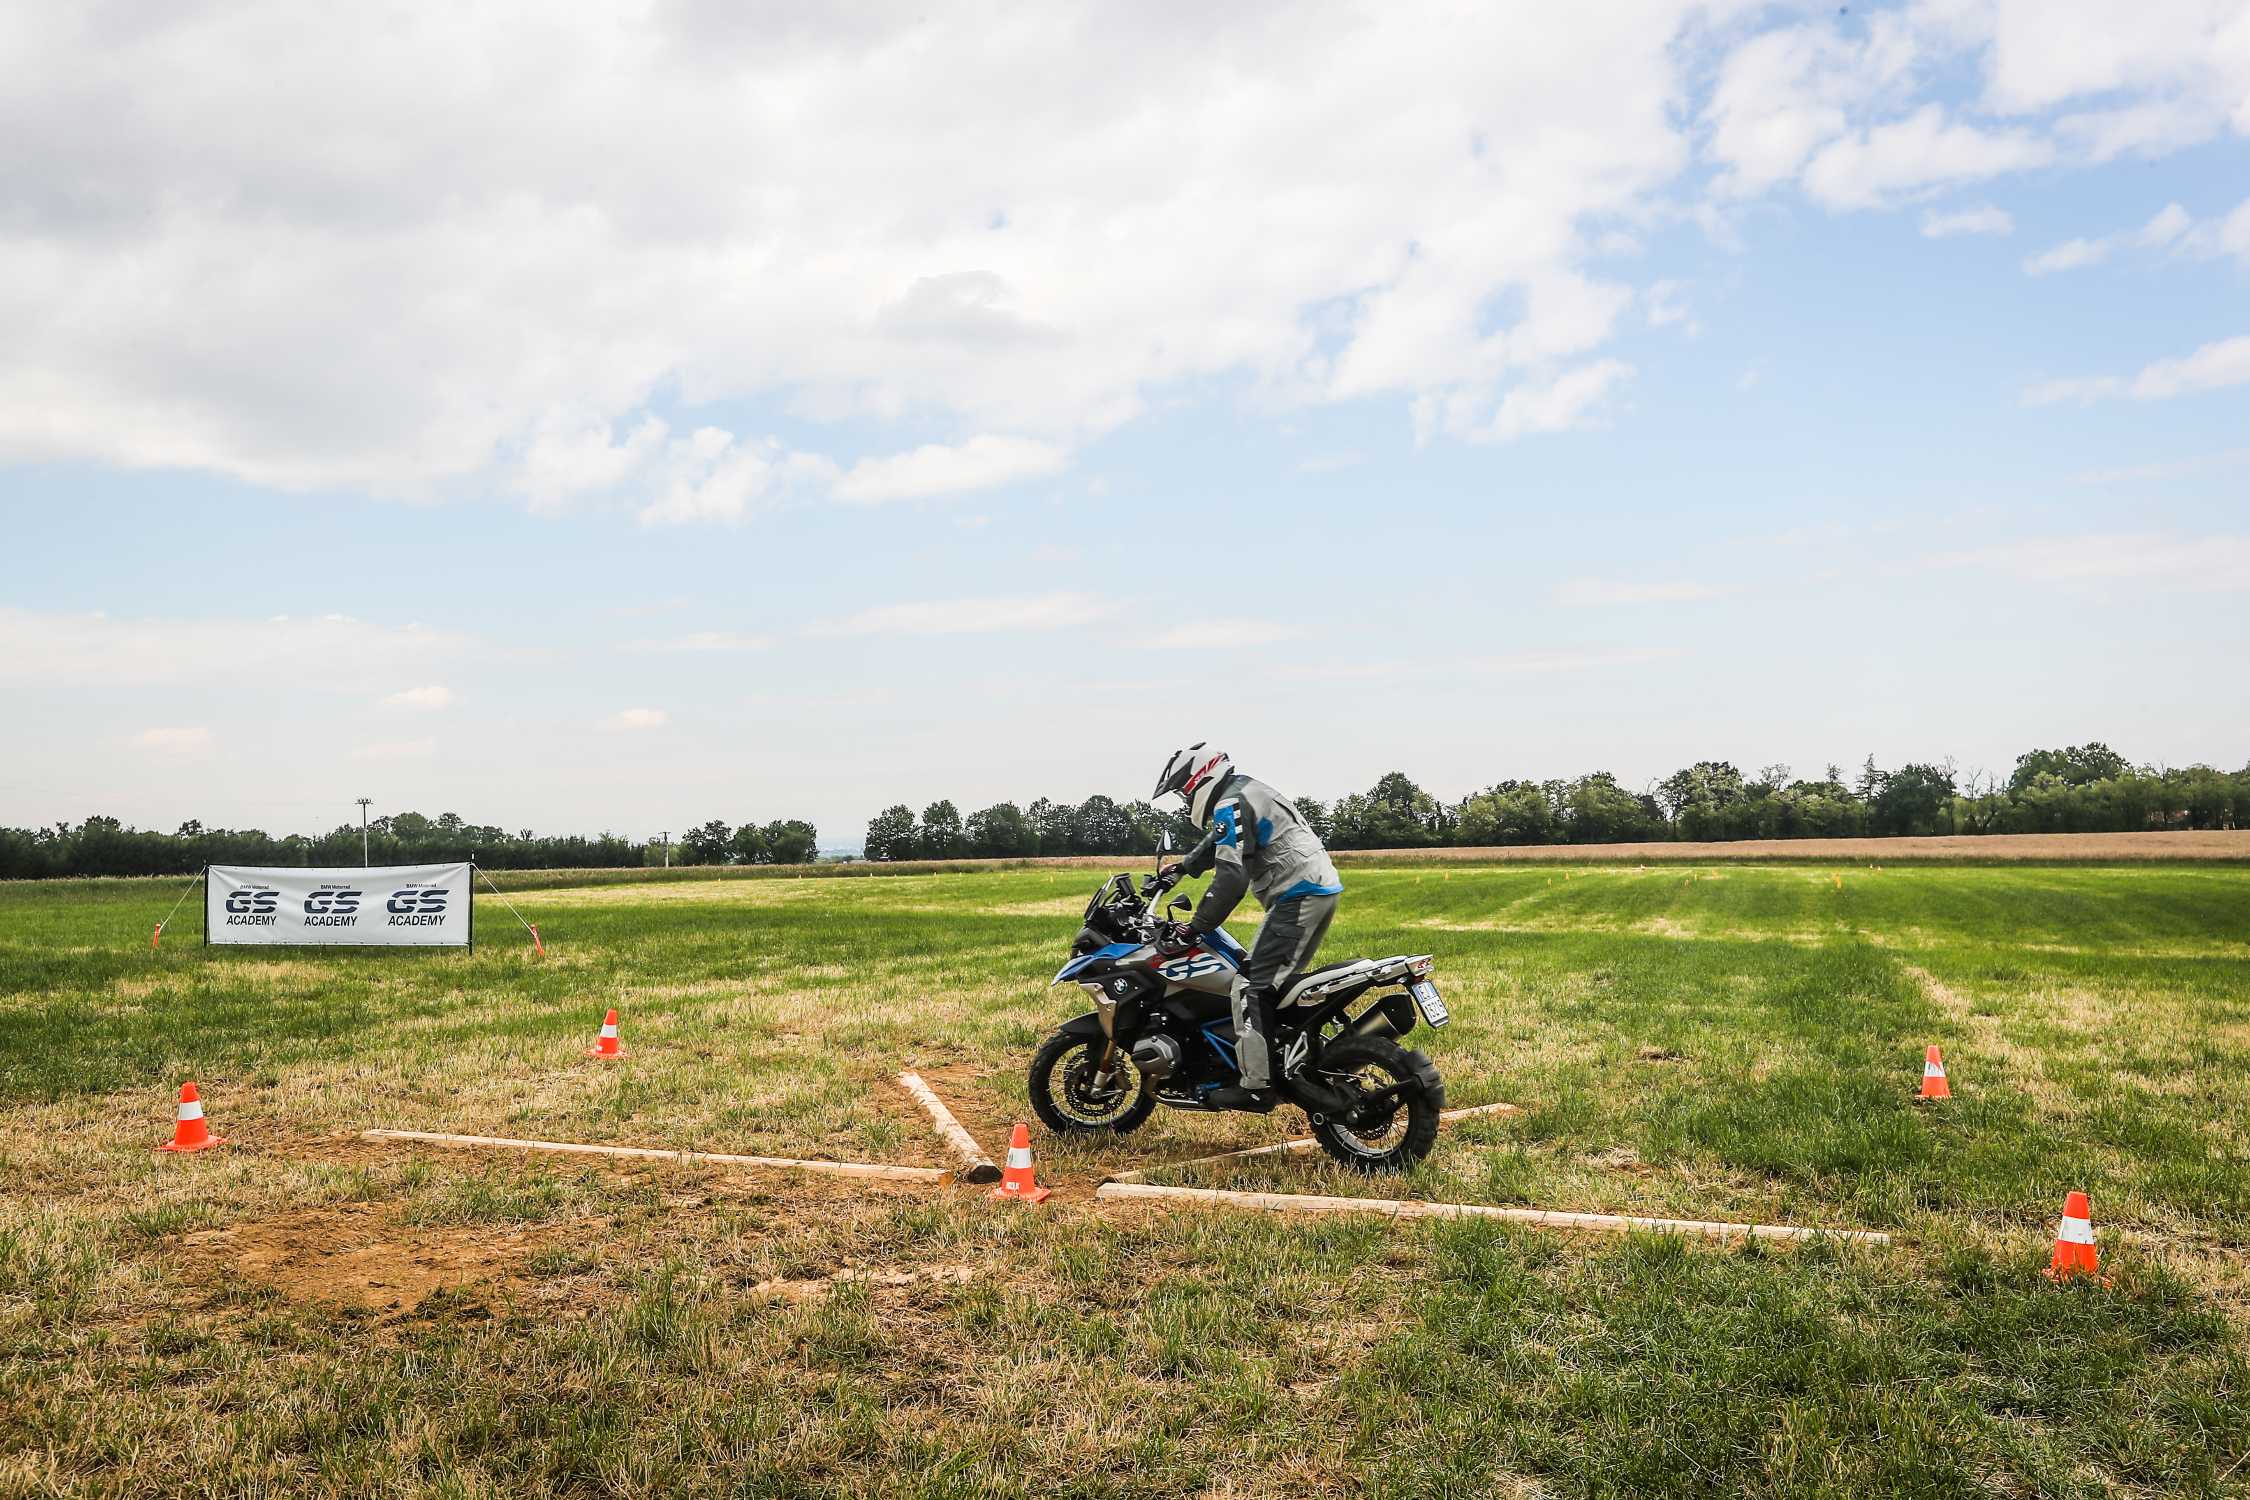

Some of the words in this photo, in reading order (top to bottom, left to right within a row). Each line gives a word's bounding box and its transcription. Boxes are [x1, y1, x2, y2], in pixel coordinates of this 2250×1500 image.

[225, 891, 280, 914] GS
[304, 891, 363, 914] GS
[386, 889, 450, 914] GS
[226, 915, 277, 926] ACADEMY
[304, 915, 358, 927] ACADEMY
[387, 914, 447, 926] ACADEMY
[1156, 952, 1223, 982] GS
